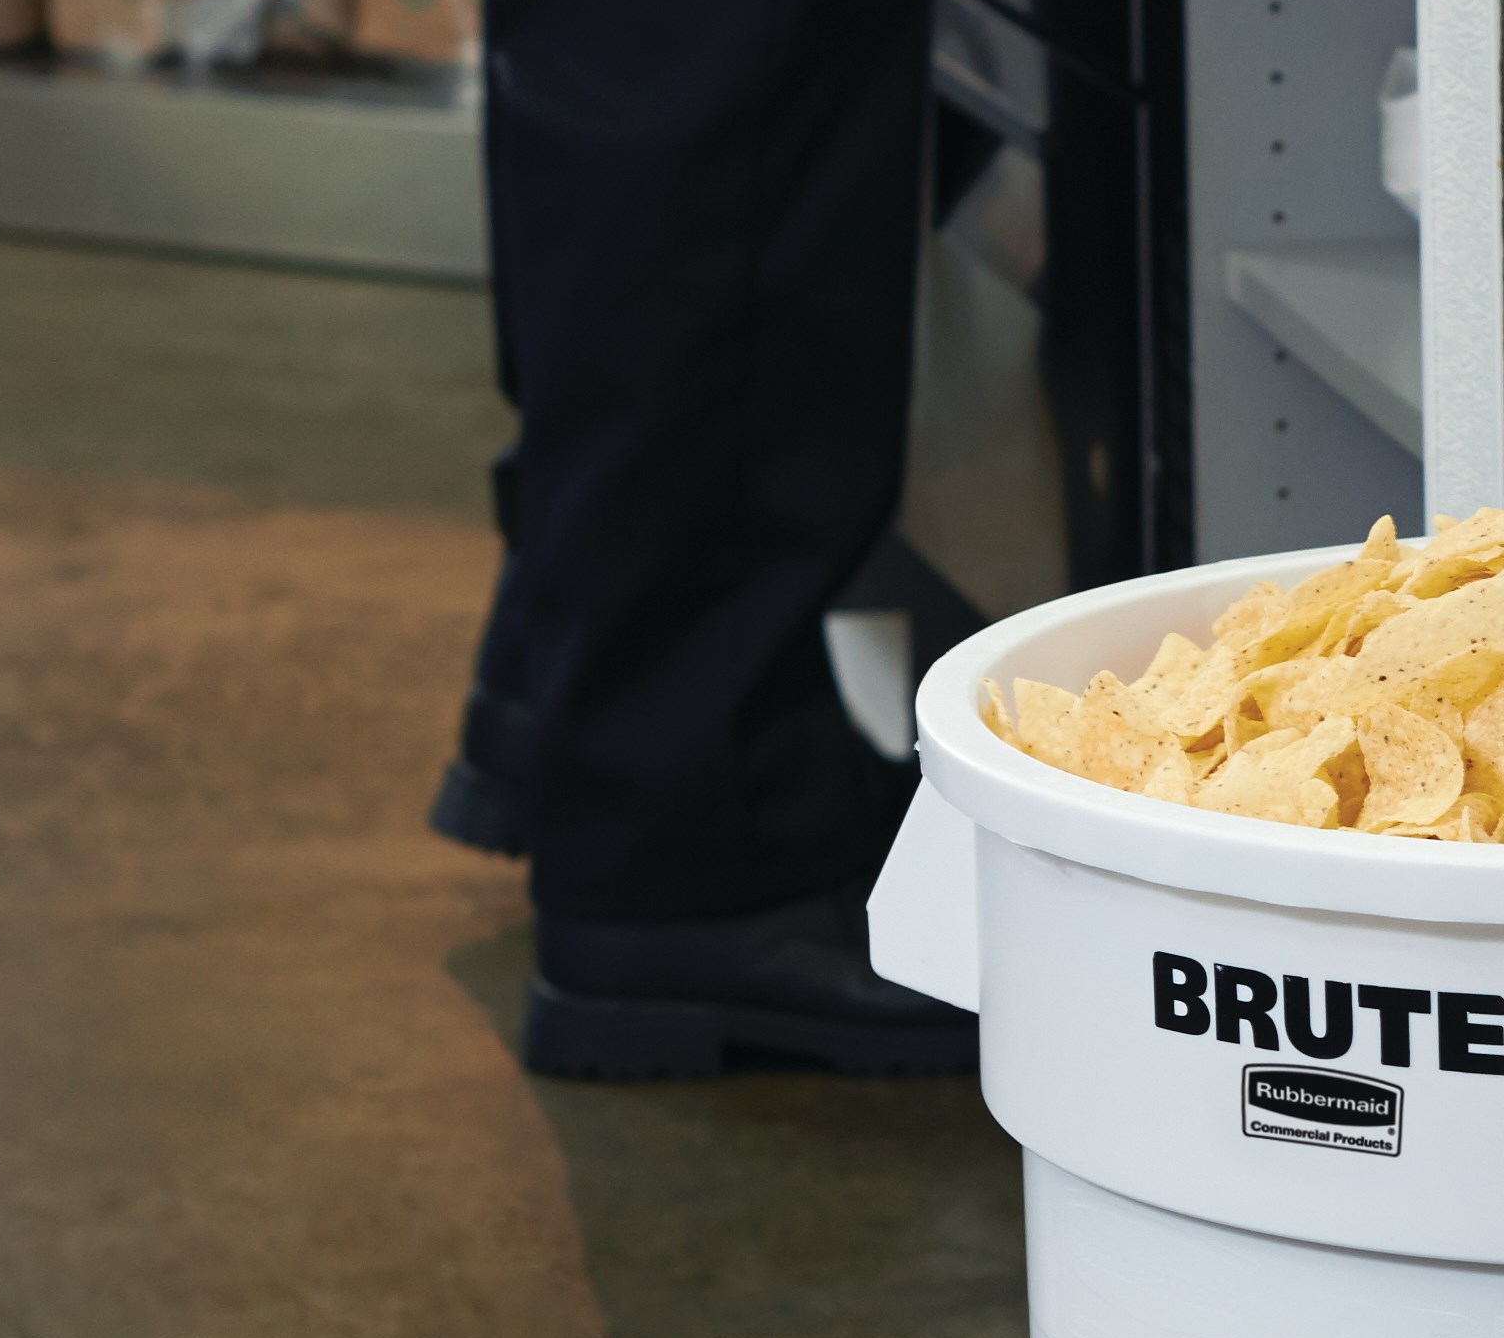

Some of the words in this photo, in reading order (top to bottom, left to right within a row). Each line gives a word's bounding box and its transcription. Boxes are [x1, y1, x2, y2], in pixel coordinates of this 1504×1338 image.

[1256, 1081, 1390, 1115] Rubbermaid
[1250, 1120, 1330, 1142] Commercial
[1333, 1132, 1393, 1151] Products
